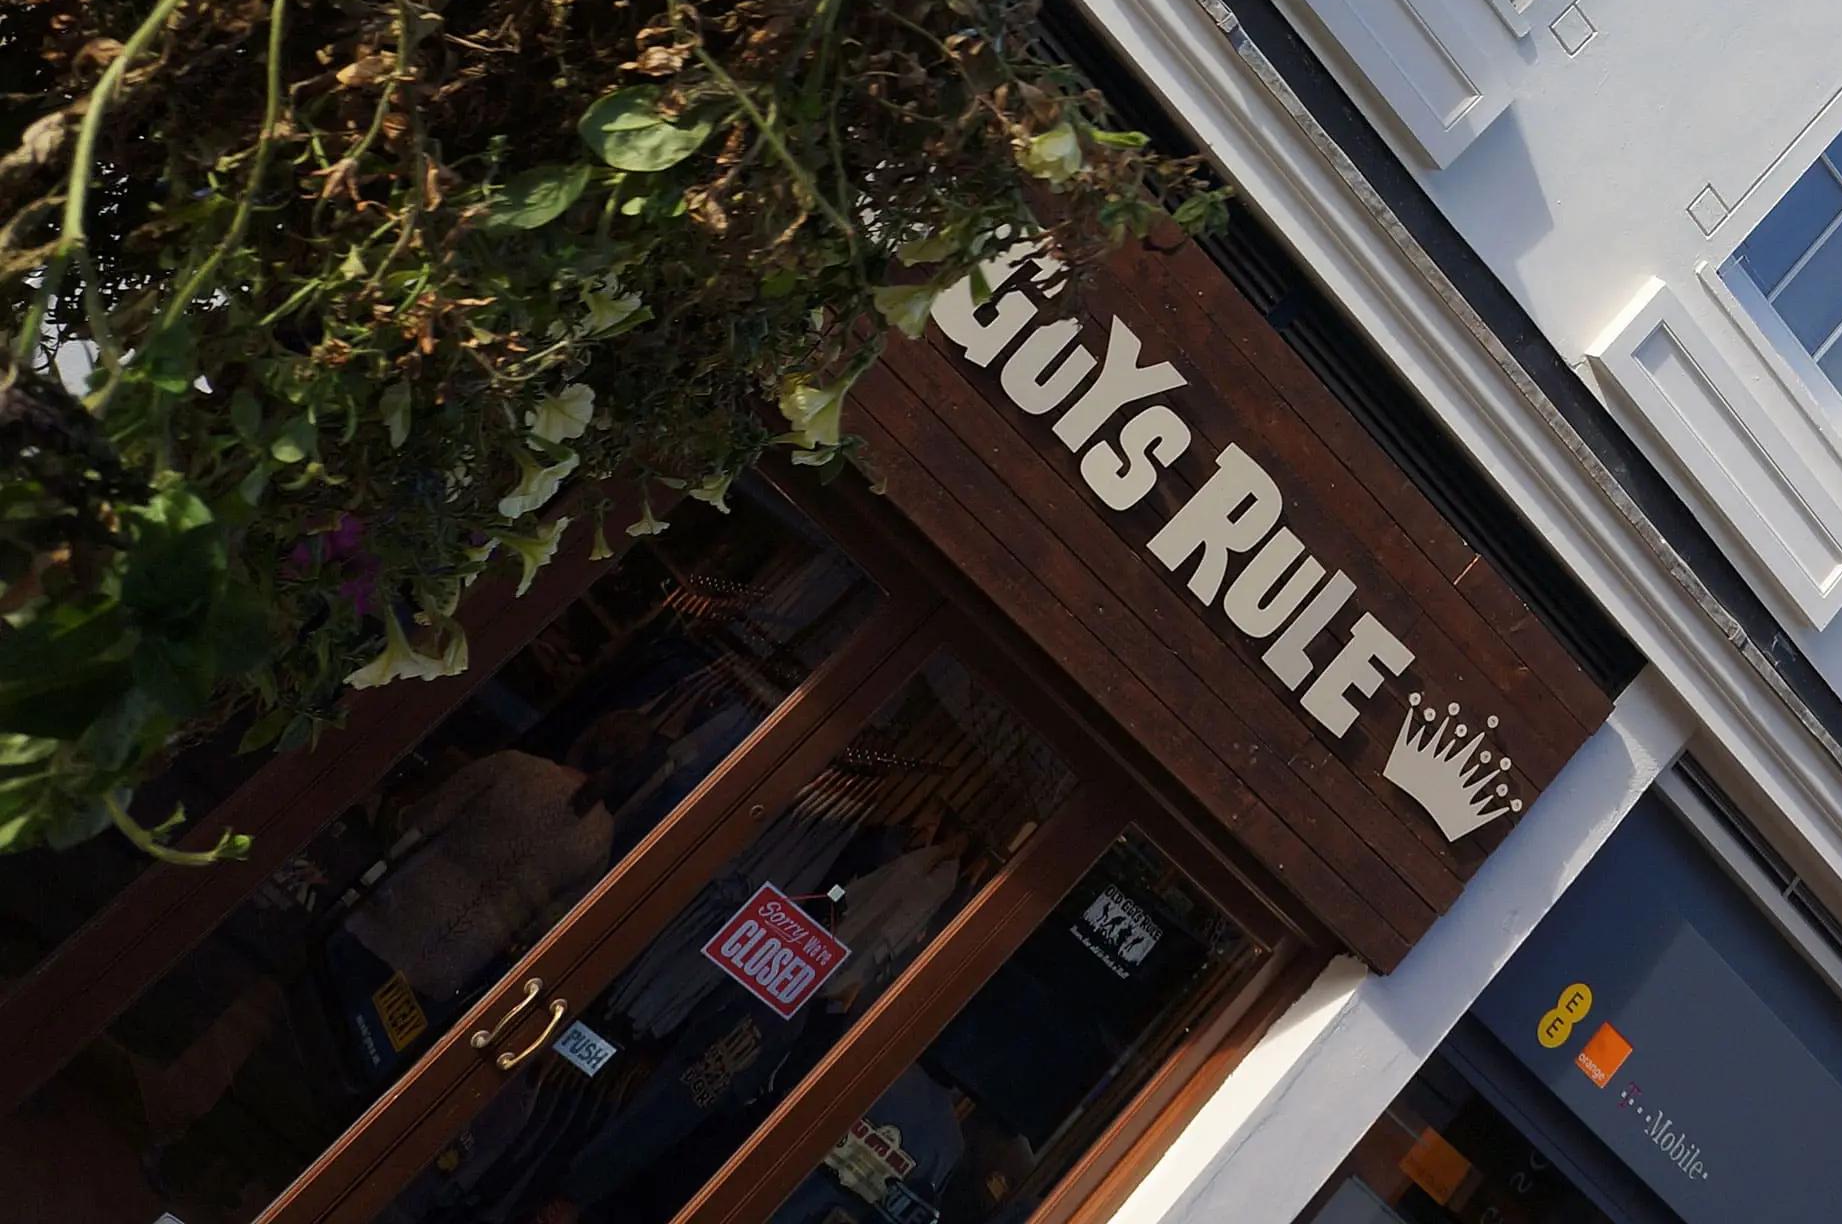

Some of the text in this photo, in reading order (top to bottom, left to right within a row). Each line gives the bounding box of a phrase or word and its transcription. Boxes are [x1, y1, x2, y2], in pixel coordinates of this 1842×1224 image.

[930, 226, 1416, 739] GUYS RULE
[720, 919, 816, 1004] CLOSED
[758, 901, 833, 966] Sorry We're
[561, 1029, 609, 1069] PUSH
[1577, 1052, 1606, 1081] orange
